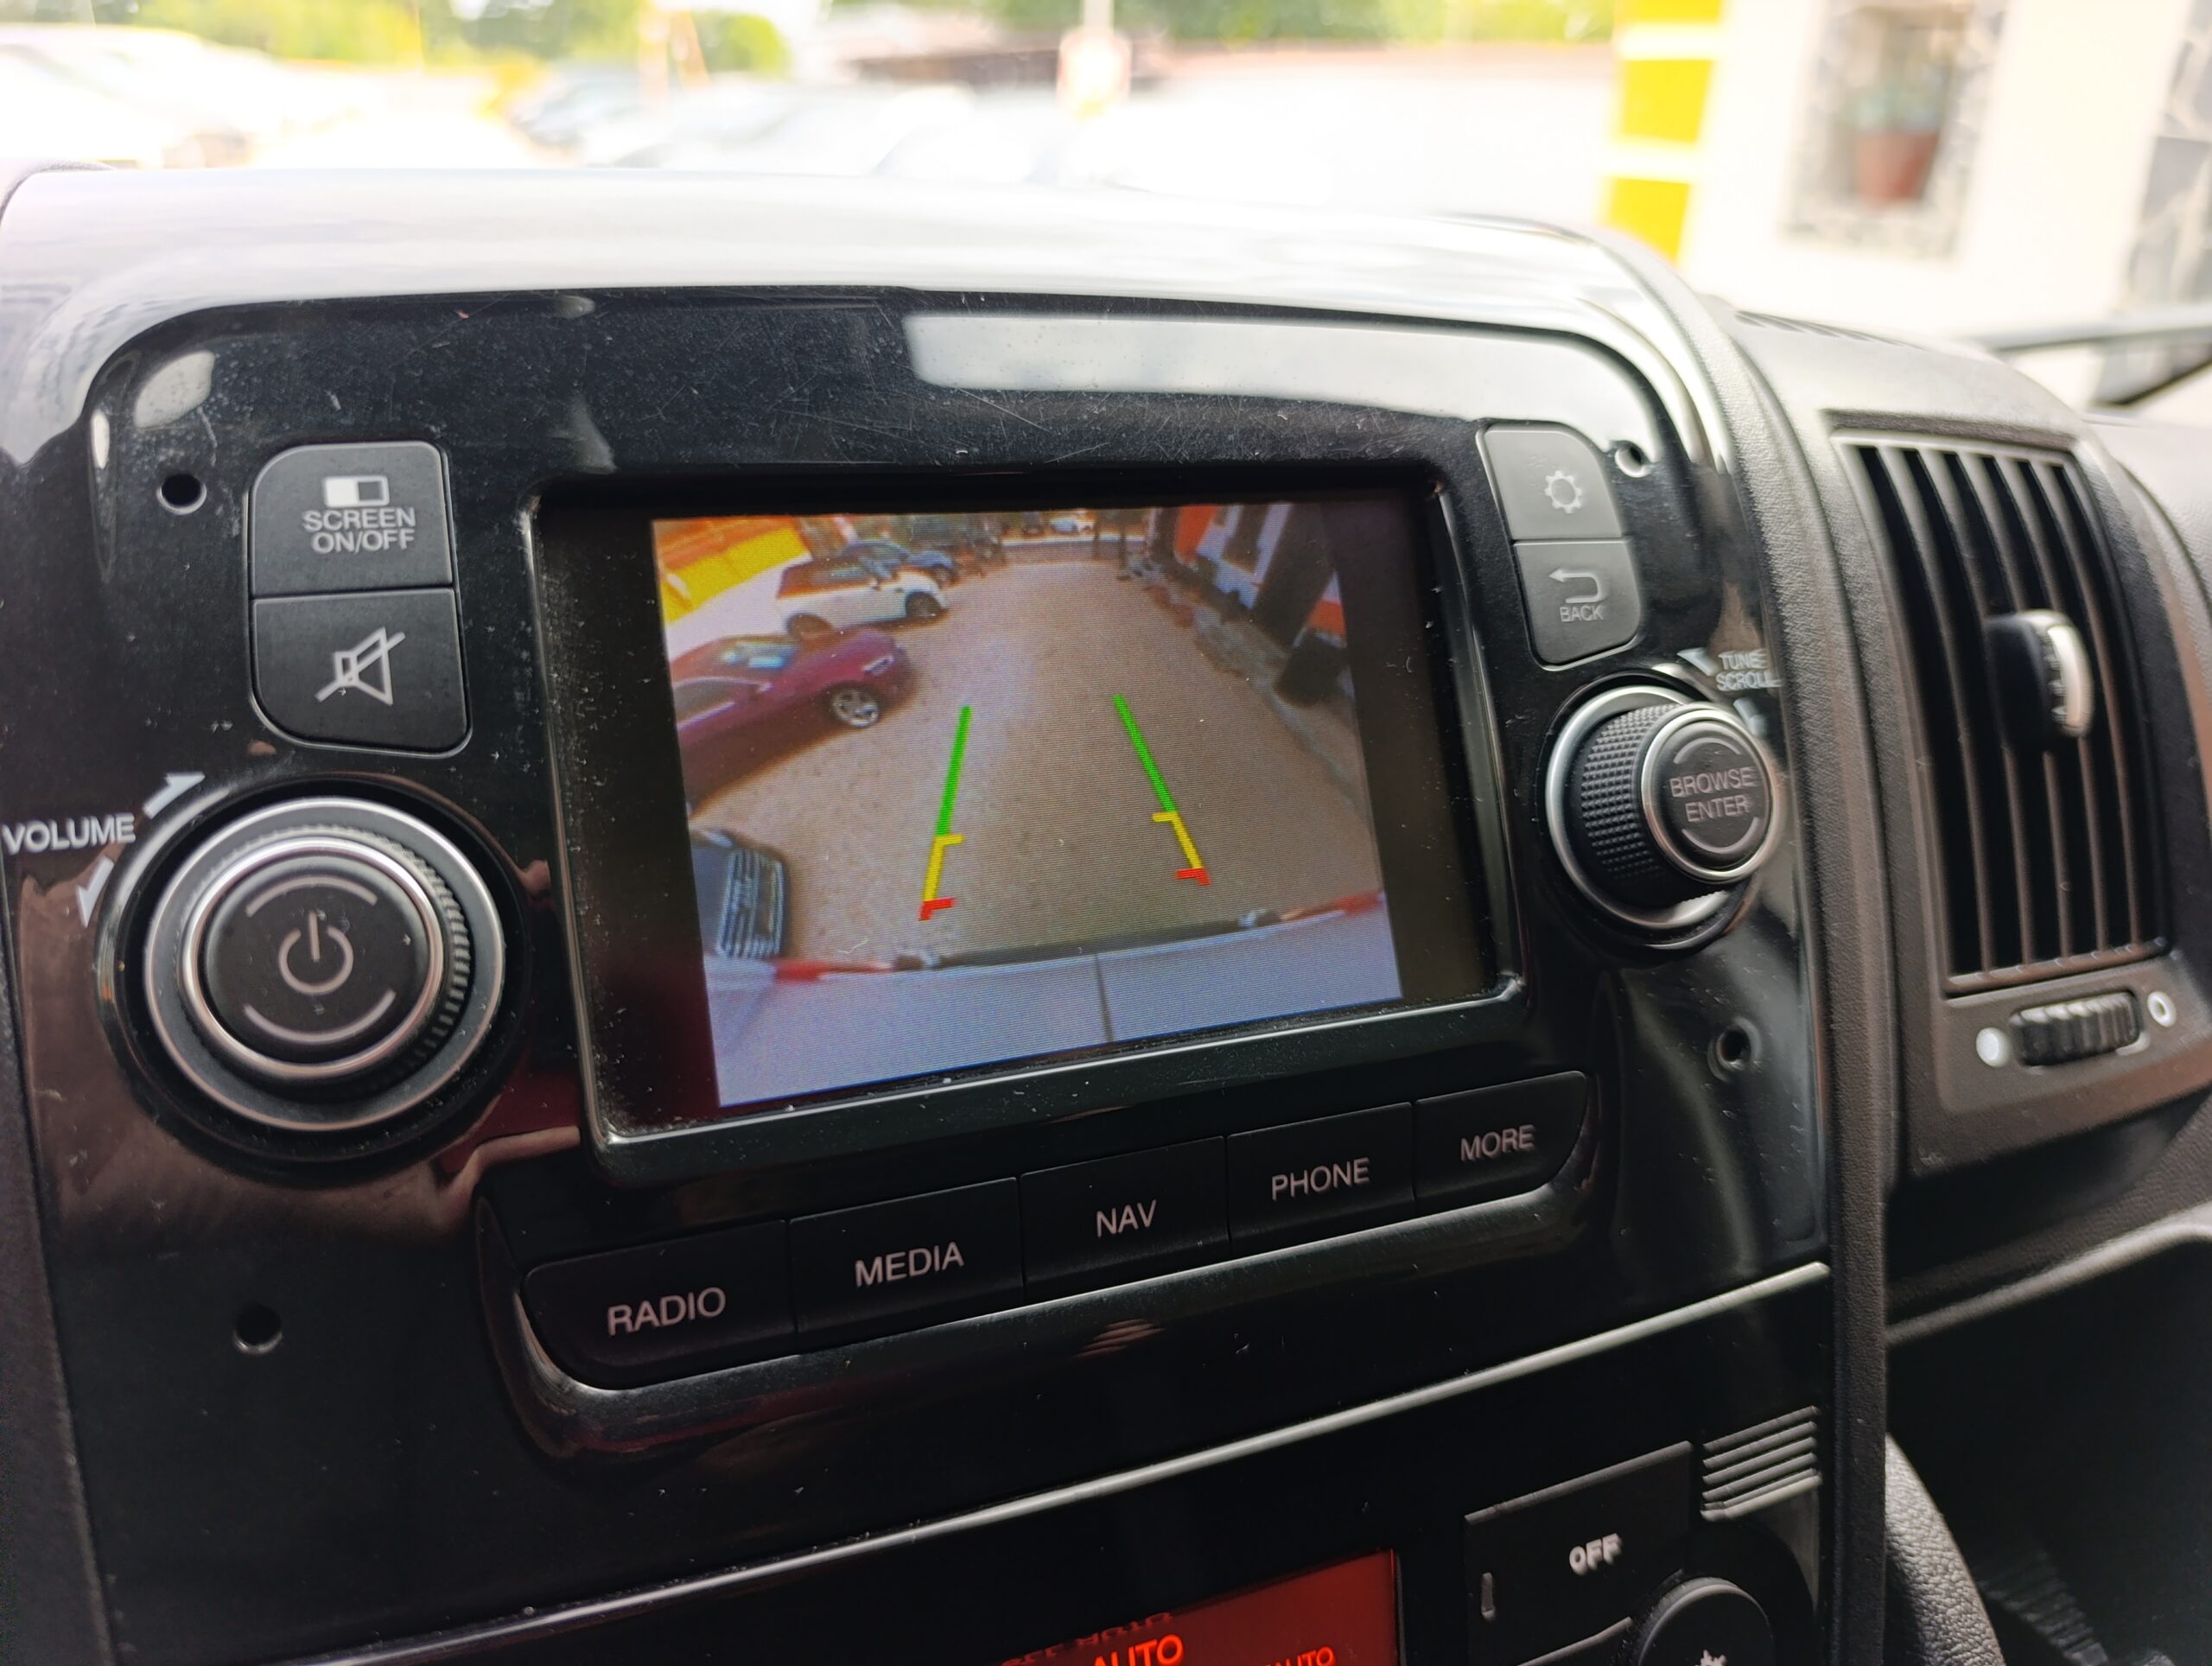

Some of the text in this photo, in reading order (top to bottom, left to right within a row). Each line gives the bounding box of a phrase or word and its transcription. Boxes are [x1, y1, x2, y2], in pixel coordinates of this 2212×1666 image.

[304, 507, 416, 532] SCREEN
[312, 528, 415, 554] ON/OFF
[1560, 605, 1604, 622] BACK
[1718, 650, 1769, 671] TUNE
[1716, 670, 1783, 691] SCROLL
[1669, 766, 1758, 798] BROWSE
[1685, 794, 1750, 822] ENTER
[2, 812, 136, 855] VOLUME
[1460, 1124, 1535, 1161] MORE
[1271, 1157, 1370, 1200] PHONE
[1096, 1199, 1157, 1237] NAV
[855, 1242, 965, 1288] MEDIA
[607, 1287, 727, 1337] RADIO
[1569, 1533, 1622, 1576] OFF
[1274, 1646, 1336, 1666] TO
